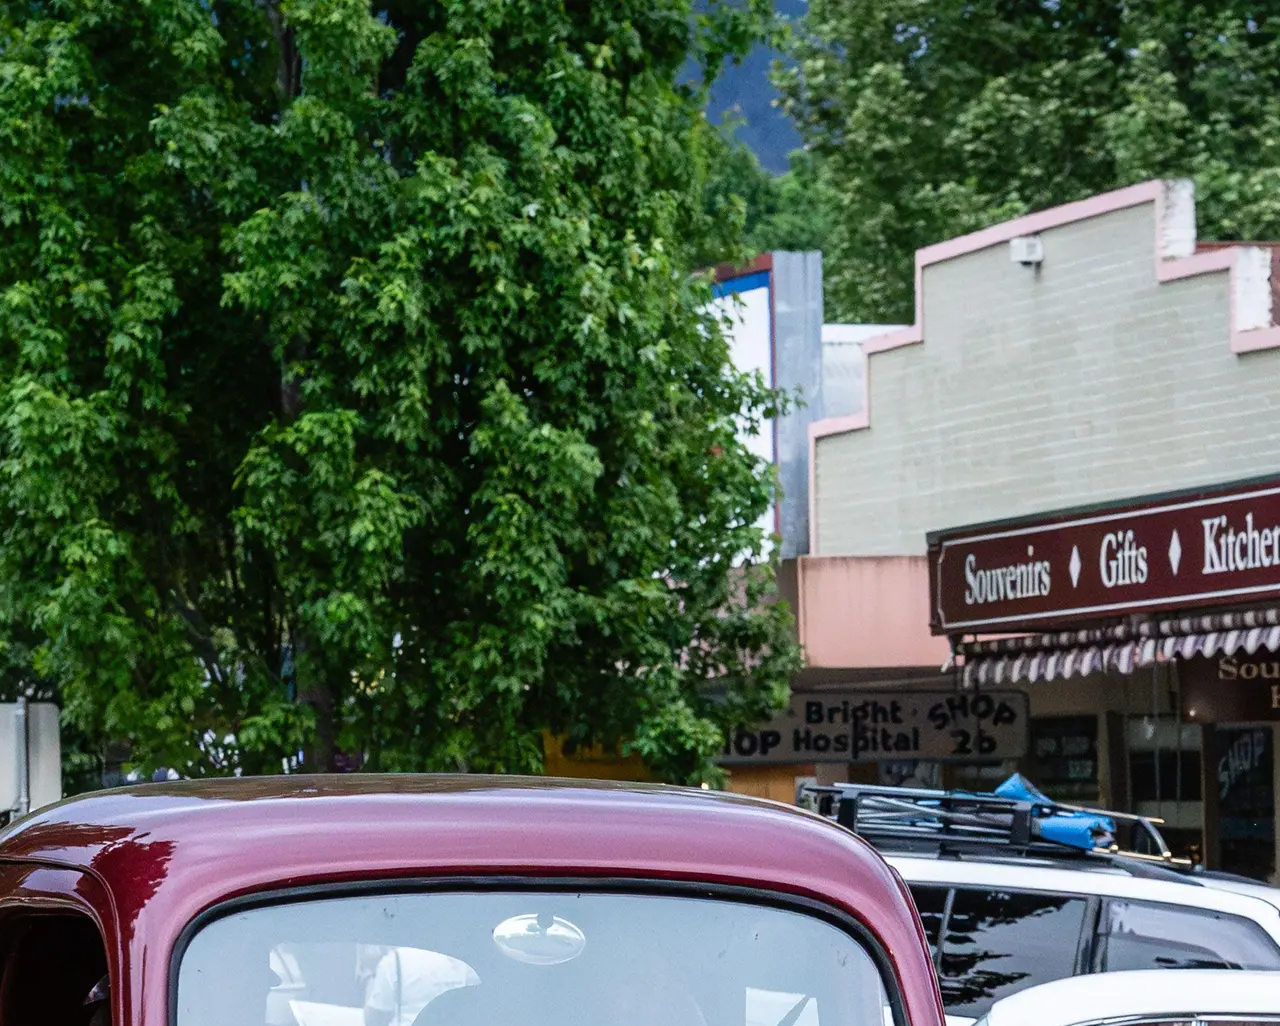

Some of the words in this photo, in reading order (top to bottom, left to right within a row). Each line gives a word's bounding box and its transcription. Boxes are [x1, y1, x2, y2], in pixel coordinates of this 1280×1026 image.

[964, 545, 1051, 605] Souvenirs
[1099, 529, 1149, 588] Gifts
[805, 700, 903, 728] Bright
[927, 694, 1018, 731] SHOP
[792, 728, 920, 760] Hospital
